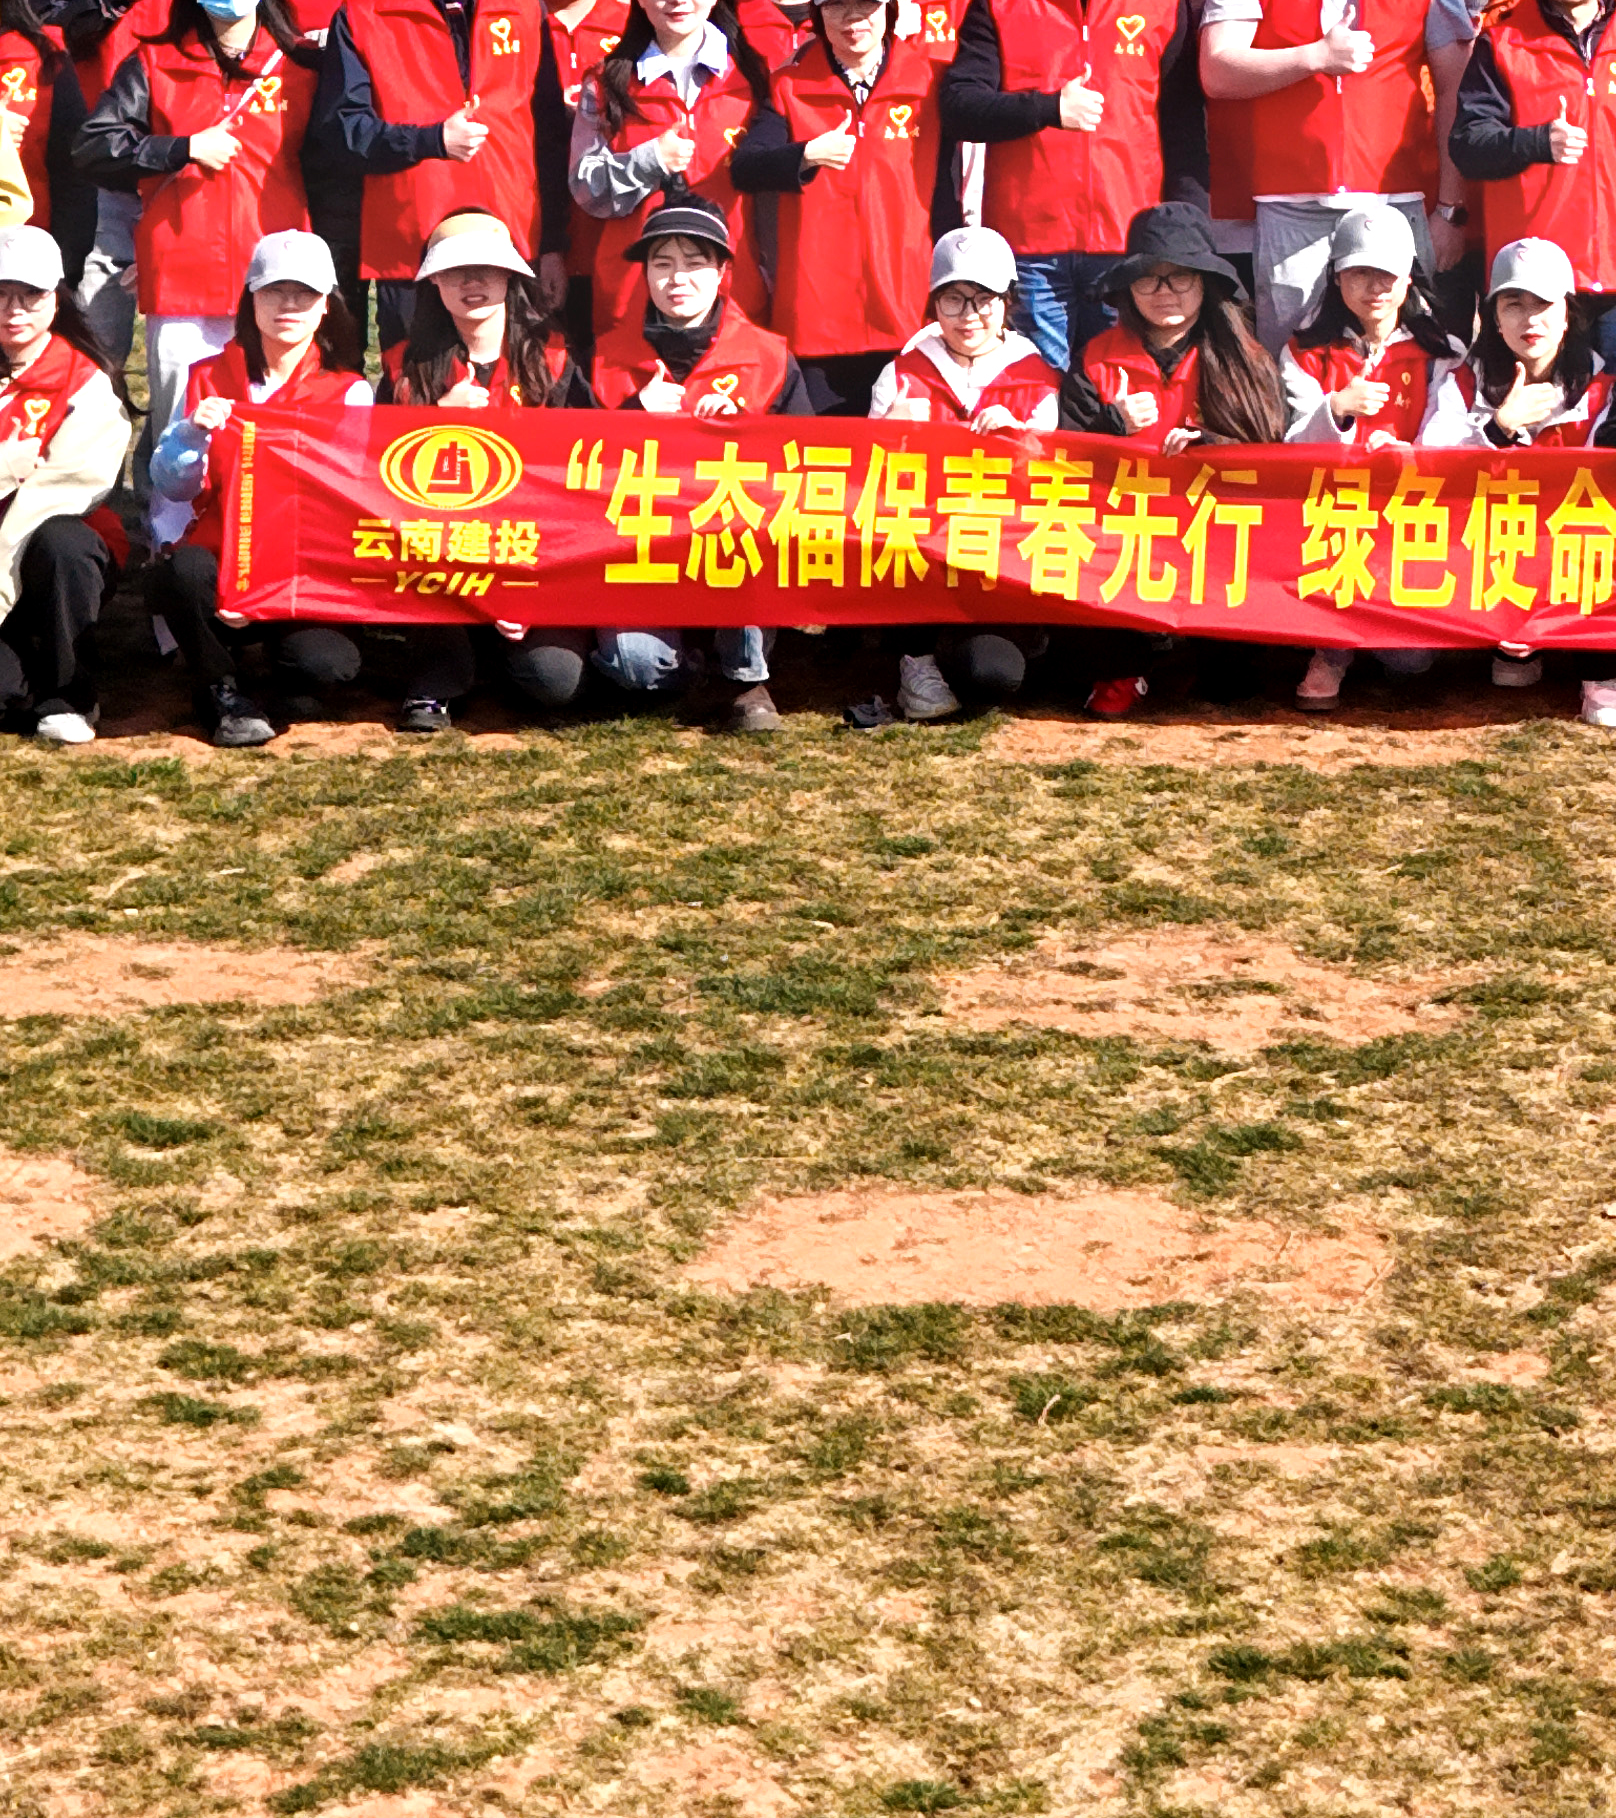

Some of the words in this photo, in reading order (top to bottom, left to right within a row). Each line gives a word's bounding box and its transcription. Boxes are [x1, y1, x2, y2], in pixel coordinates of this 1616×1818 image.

[352, 518, 541, 565] 云南建投
[566, 438, 1263, 608] “生态福保青春先行
[394, 571, 495, 597] YCIH
